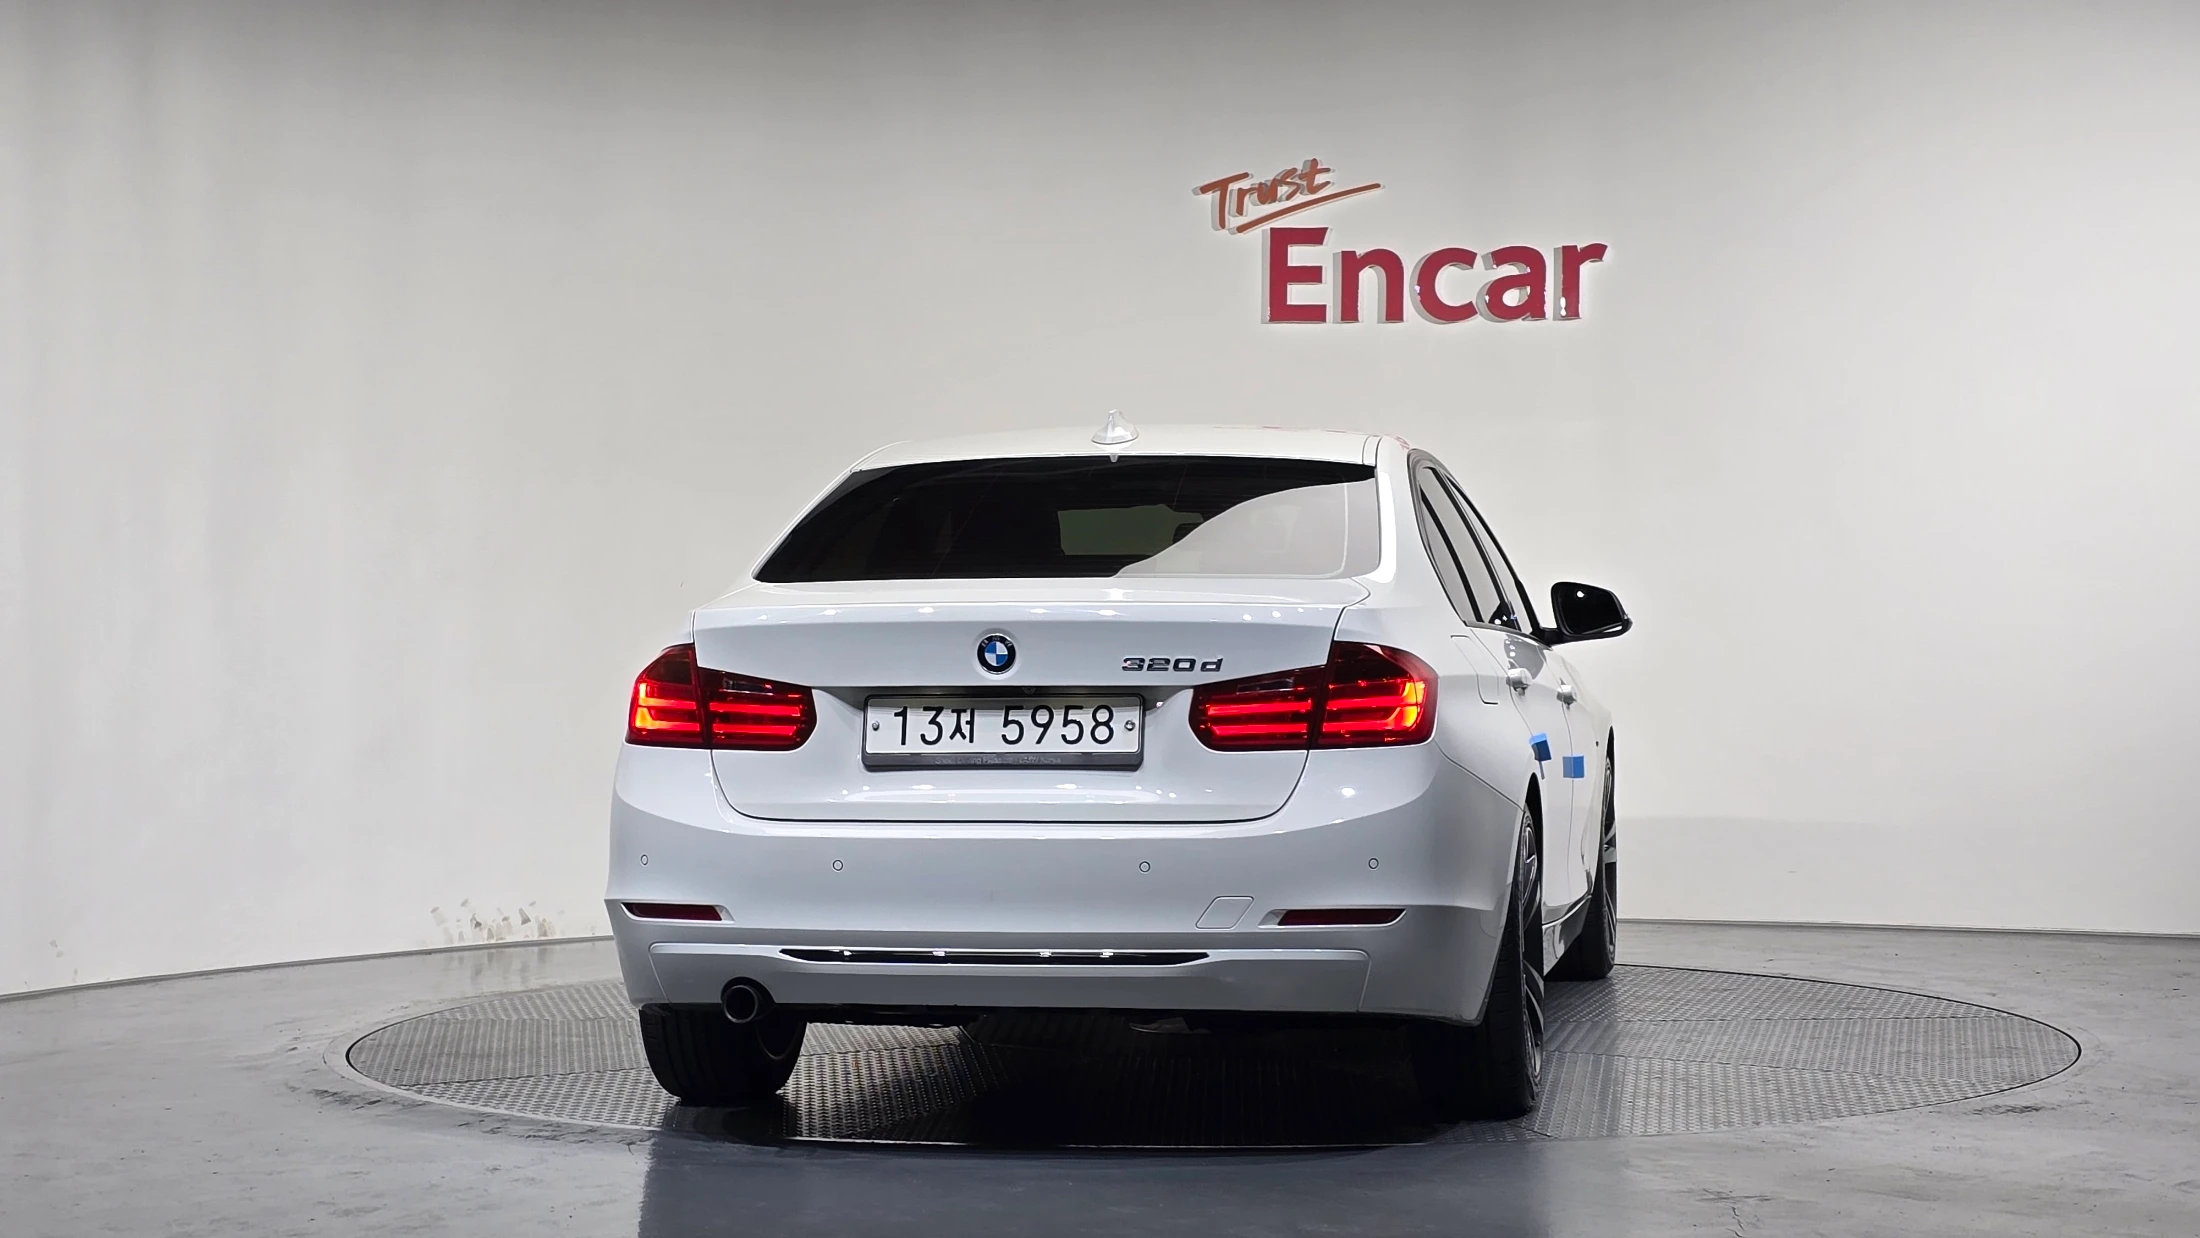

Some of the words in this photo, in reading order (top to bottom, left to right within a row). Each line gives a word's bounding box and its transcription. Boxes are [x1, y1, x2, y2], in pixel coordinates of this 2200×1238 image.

[1198, 158, 1333, 230] Trust
[1266, 226, 1608, 324] Encar
[1121, 657, 1224, 672] 320d
[893, 705, 976, 745] 13저
[1000, 704, 1115, 745] 5958
